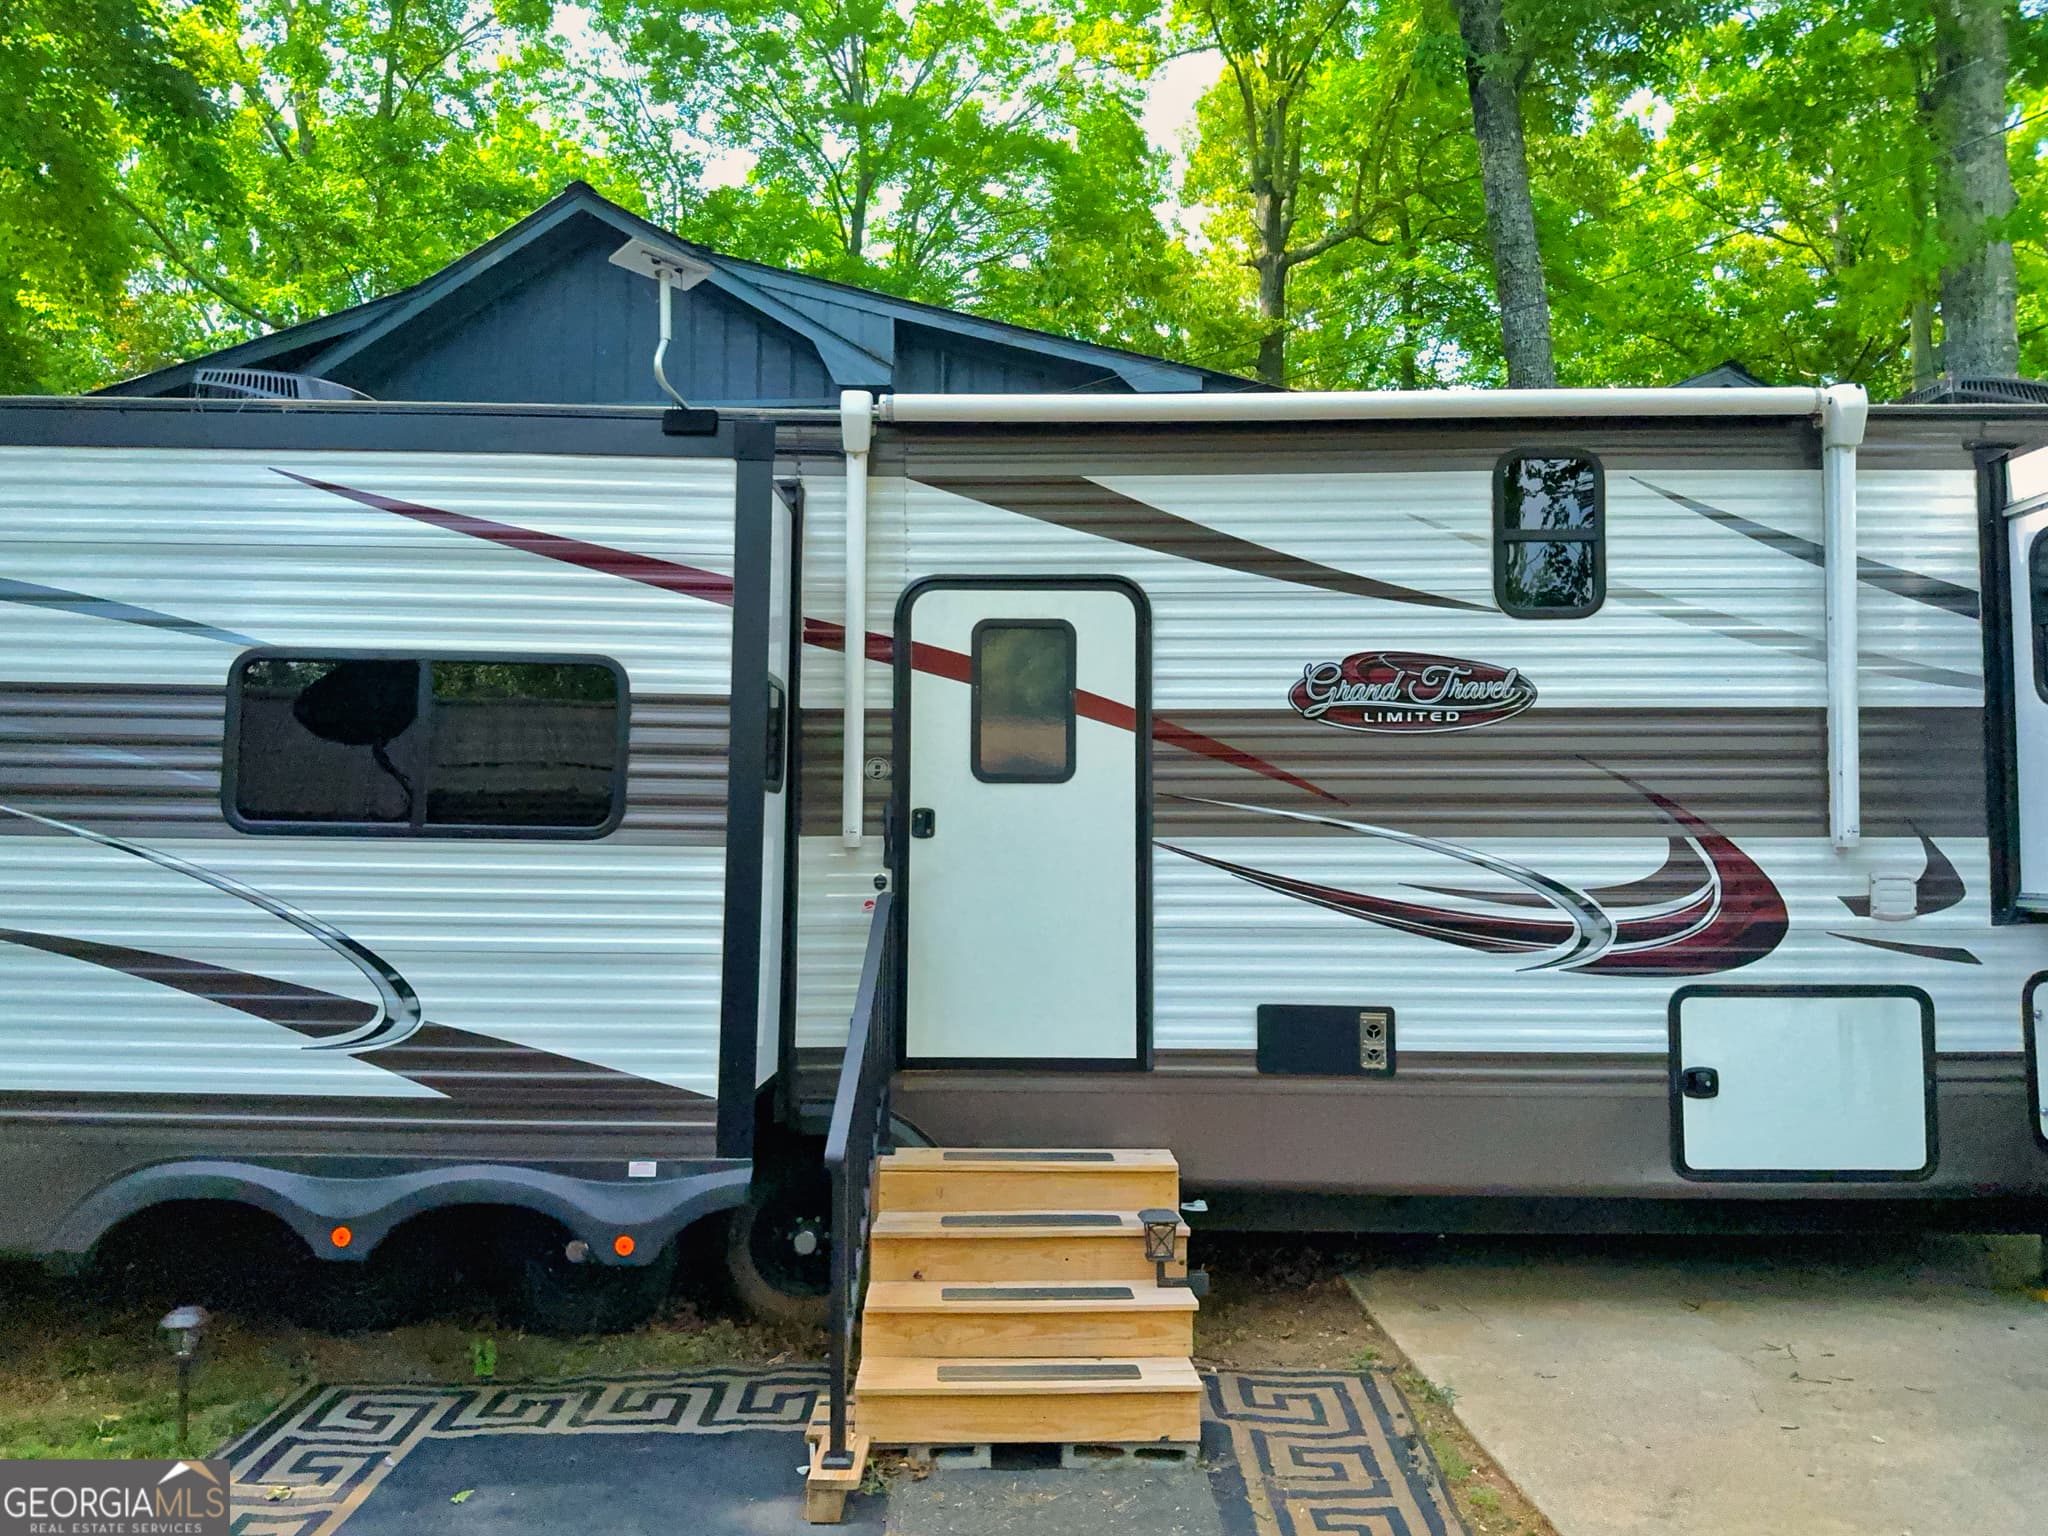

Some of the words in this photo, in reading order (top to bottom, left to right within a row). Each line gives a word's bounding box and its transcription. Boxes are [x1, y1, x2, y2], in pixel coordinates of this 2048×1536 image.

[1304, 662, 1402, 718] Grand
[1408, 665, 1522, 704] Travel
[1363, 711, 1460, 723] LIMITED
